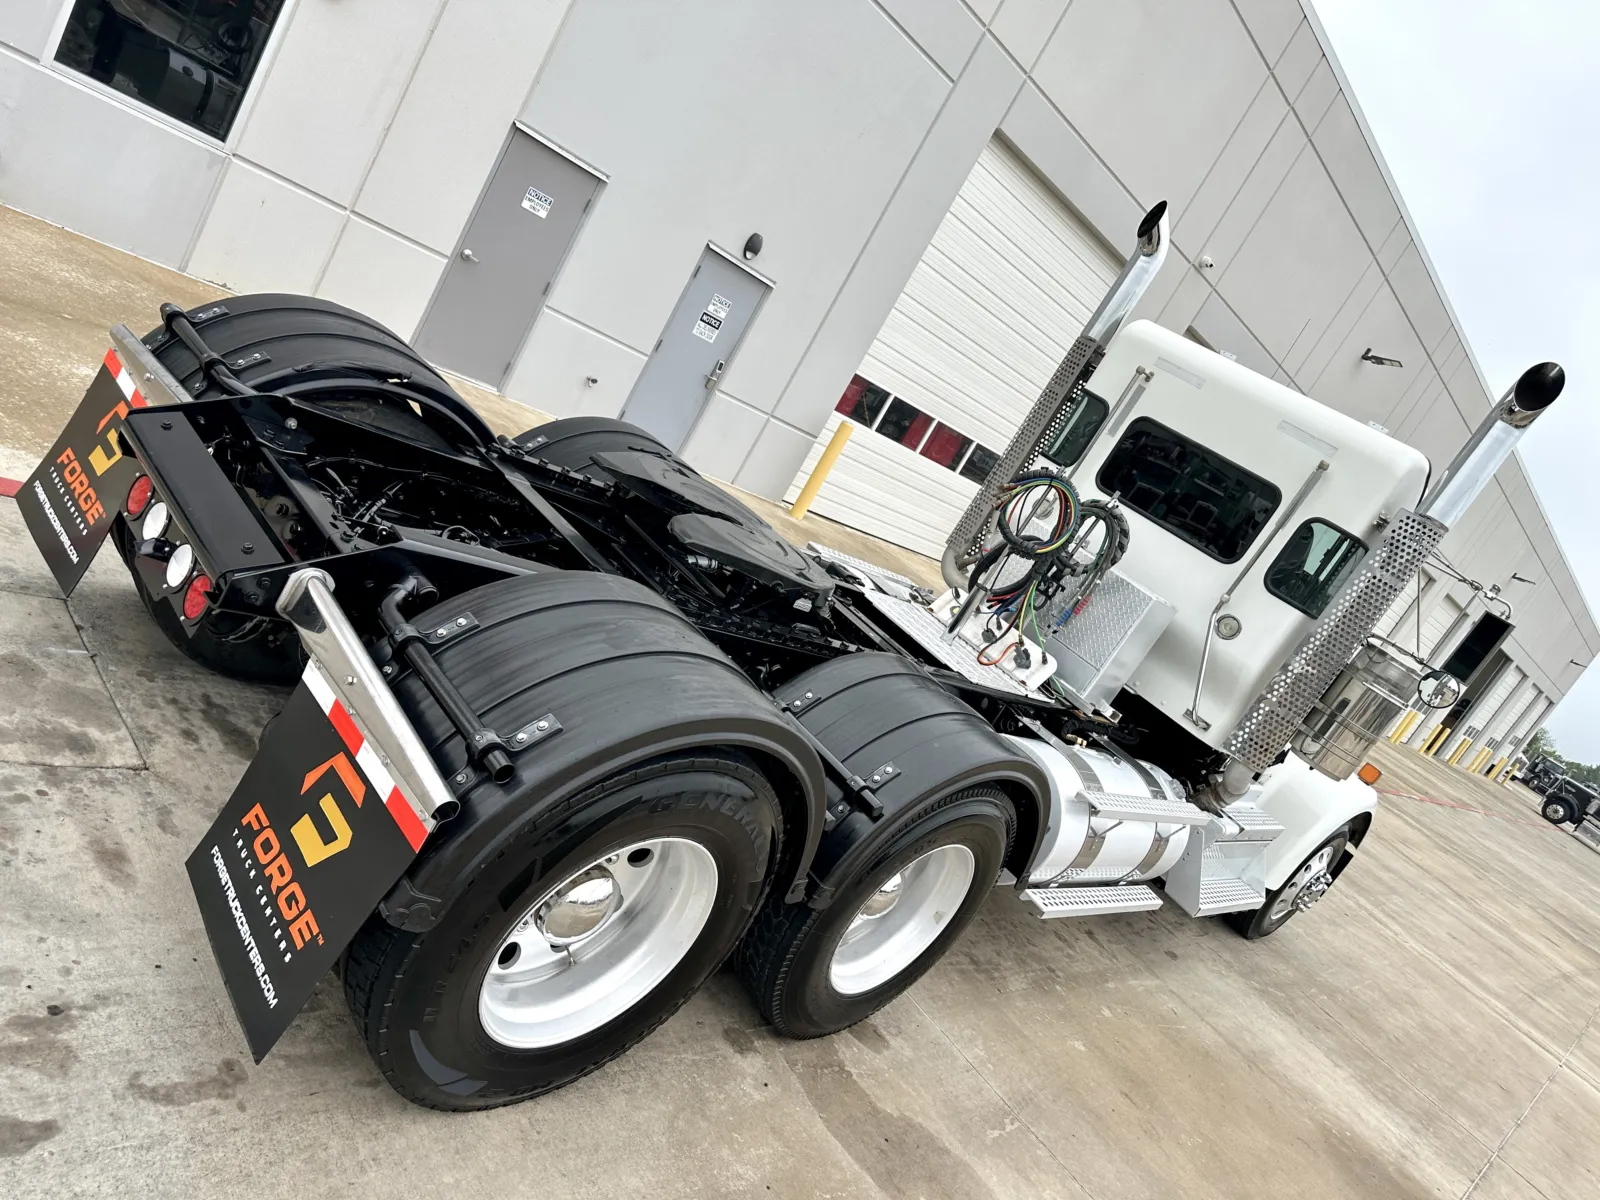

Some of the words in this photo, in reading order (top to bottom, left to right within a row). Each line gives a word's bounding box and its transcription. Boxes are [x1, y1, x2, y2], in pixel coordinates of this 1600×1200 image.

[524, 195, 549, 212] EMPLOYEES
[528, 188, 552, 205] NOTICE
[528, 204, 540, 213] ONLY
[701, 313, 720, 327] NOTICE
[712, 294, 731, 308] NOTICE
[49, 466, 65, 495] TRUCK
[63, 495, 88, 536] CENTERS
[32, 479, 80, 565] FORGETRUCKCENTERS.COM
[648, 791, 767, 854] GENERAL
[232, 828, 257, 880] TRUCK
[255, 884, 291, 963] CENTERS
[210, 845, 279, 1009] FORGETRUCKCENTERS.COM
